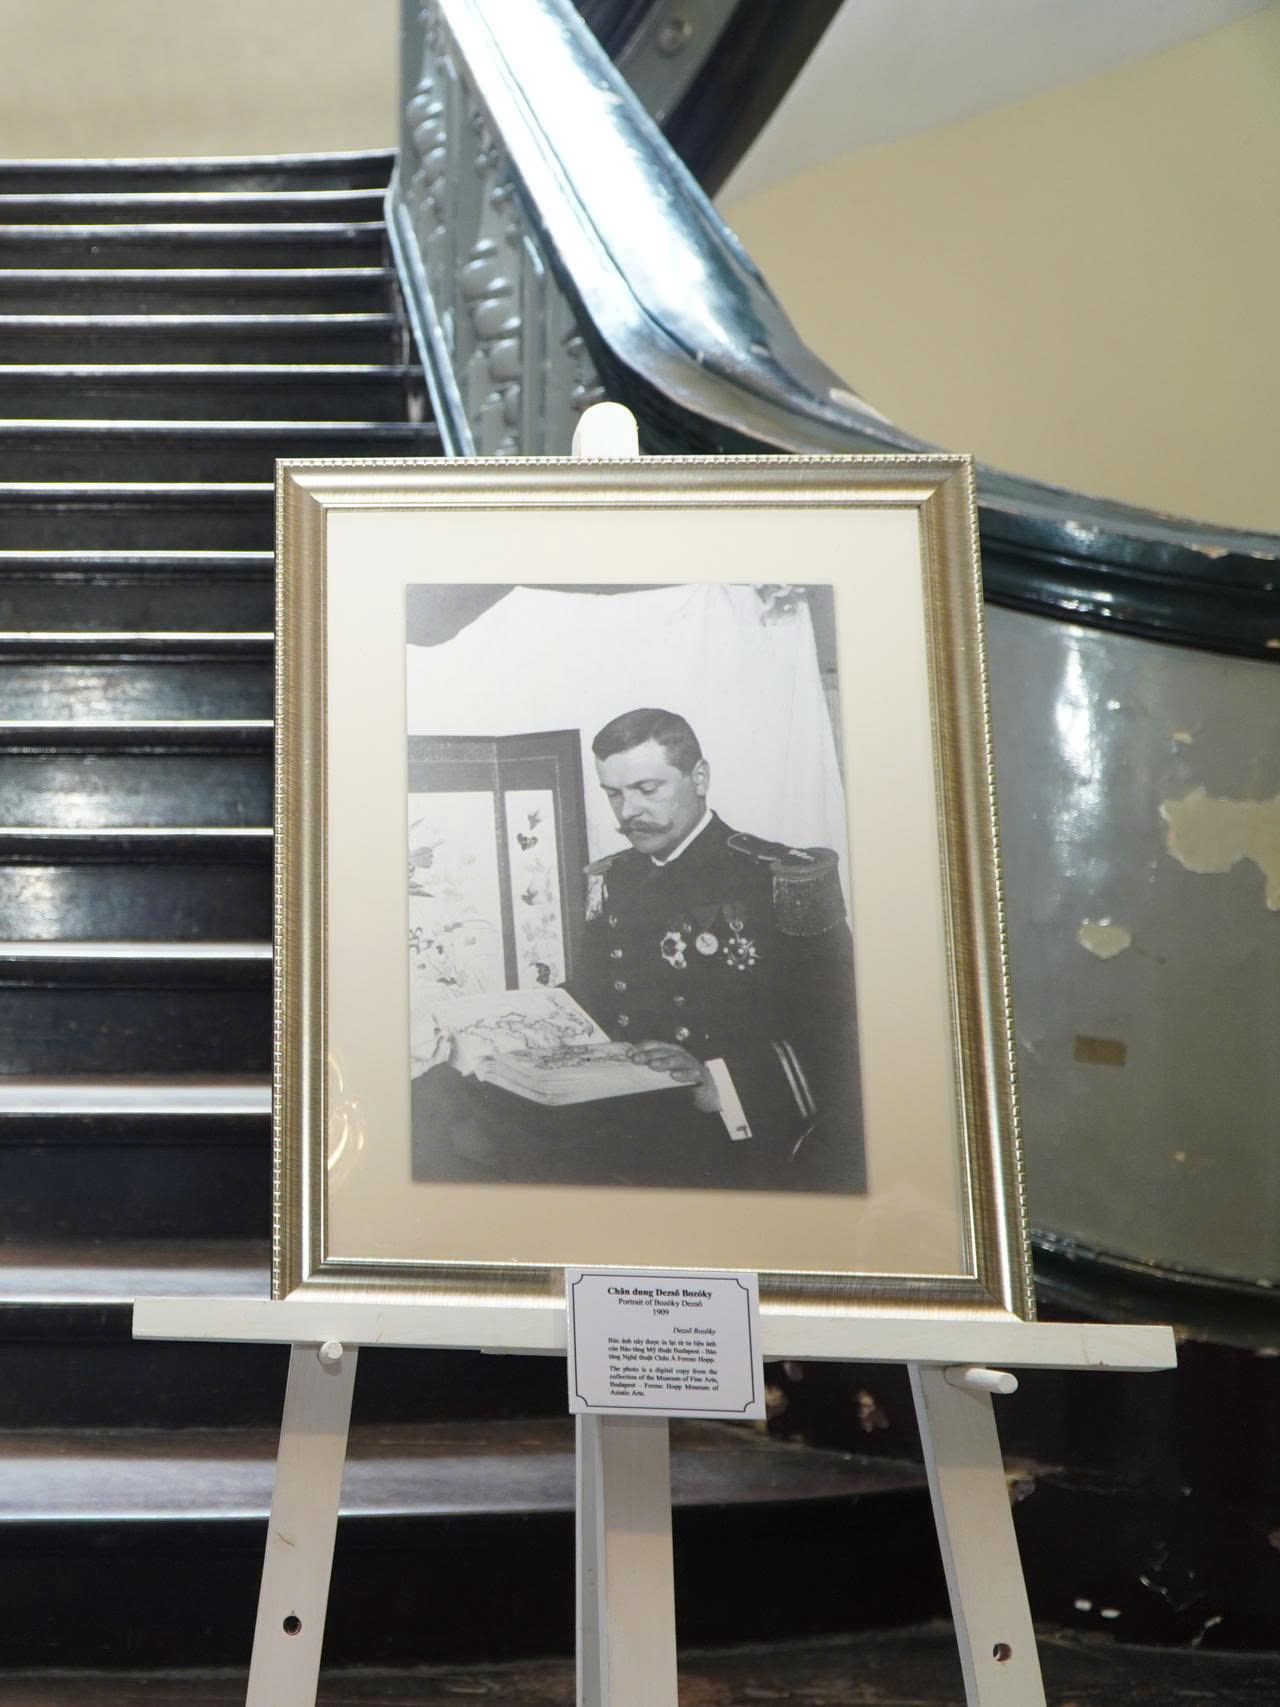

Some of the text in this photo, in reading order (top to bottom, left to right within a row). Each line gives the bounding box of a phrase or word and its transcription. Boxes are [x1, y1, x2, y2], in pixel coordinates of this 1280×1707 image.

[608, 1287, 630, 1295] Chân
[633, 1288, 653, 1297] dung
[682, 1290, 712, 1299] Bozóky
